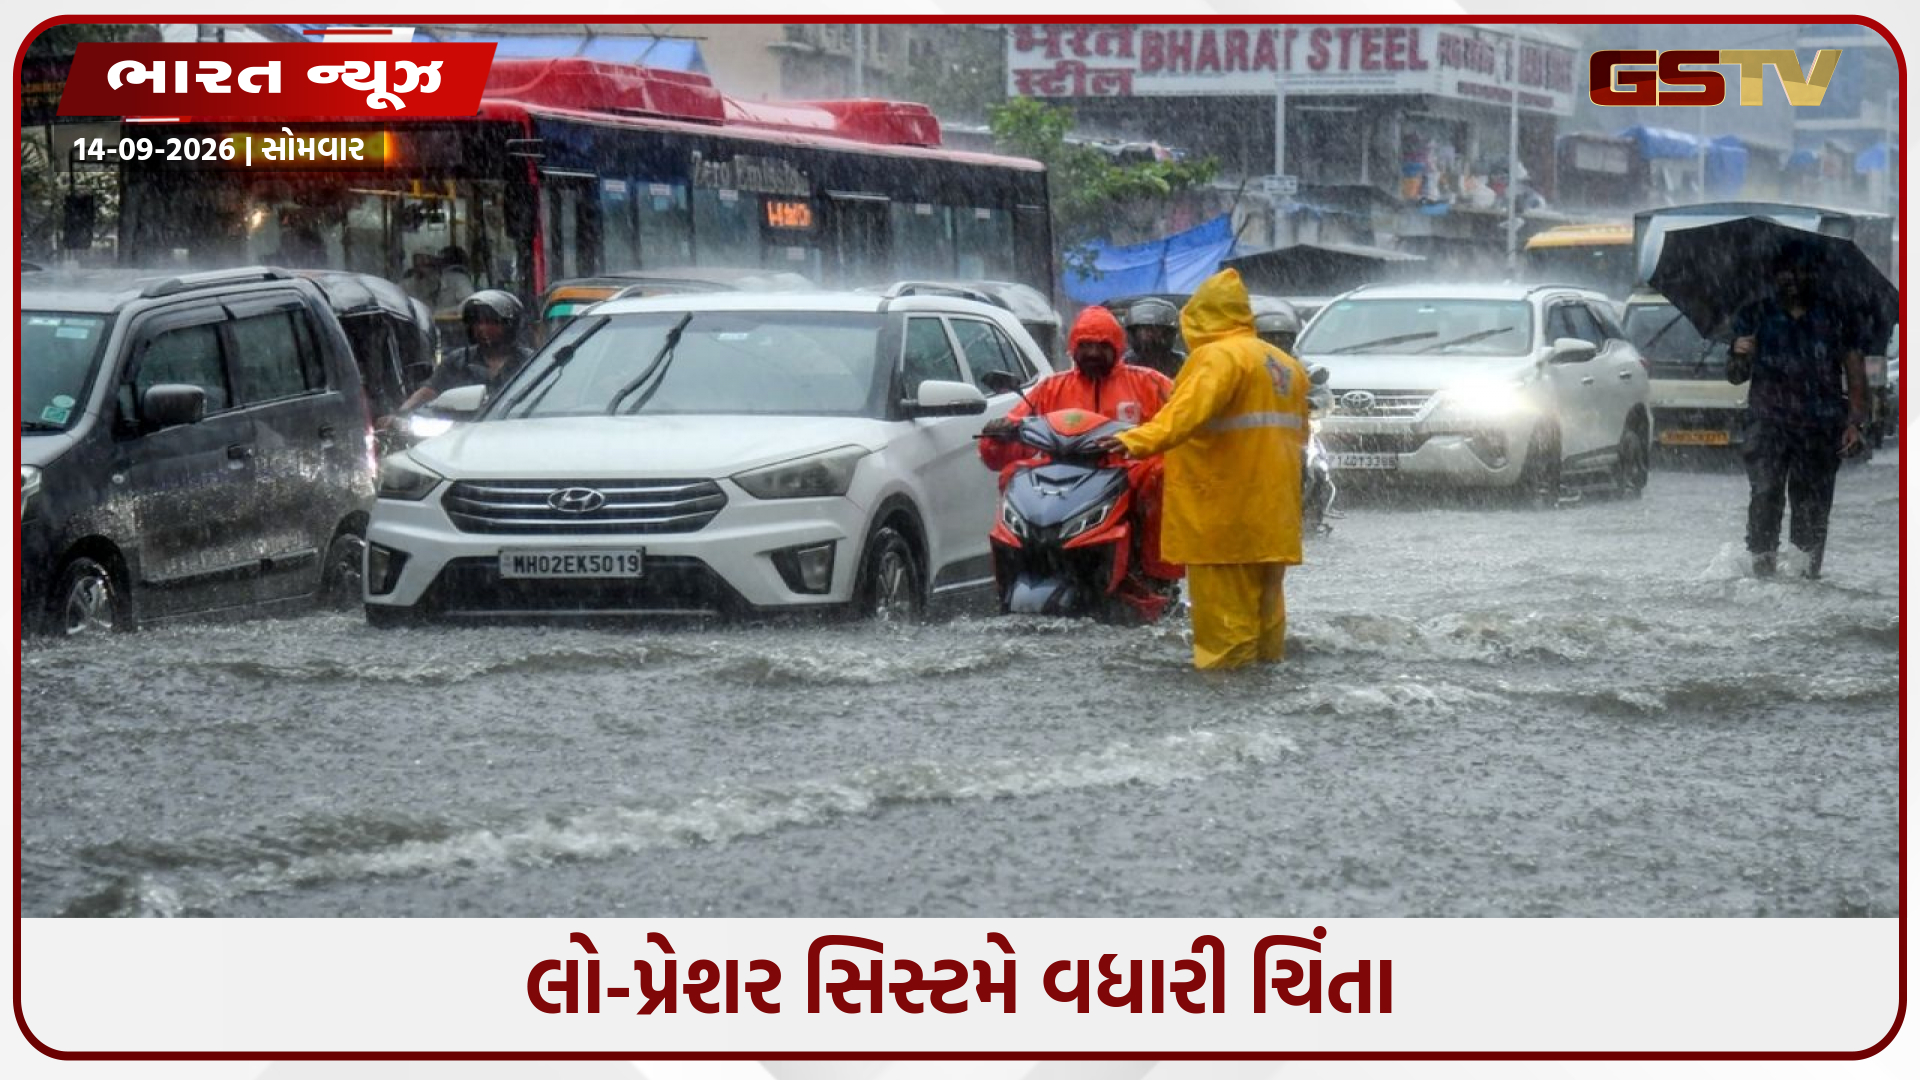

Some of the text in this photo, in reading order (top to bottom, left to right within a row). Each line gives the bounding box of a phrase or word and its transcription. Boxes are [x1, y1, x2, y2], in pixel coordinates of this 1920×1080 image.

[1140, 28, 1299, 72] BHARAT
[1306, 27, 1429, 71] STEEL
[1011, 59, 1136, 97] स्टील
[513, 555, 640, 574] MH02EK5019
